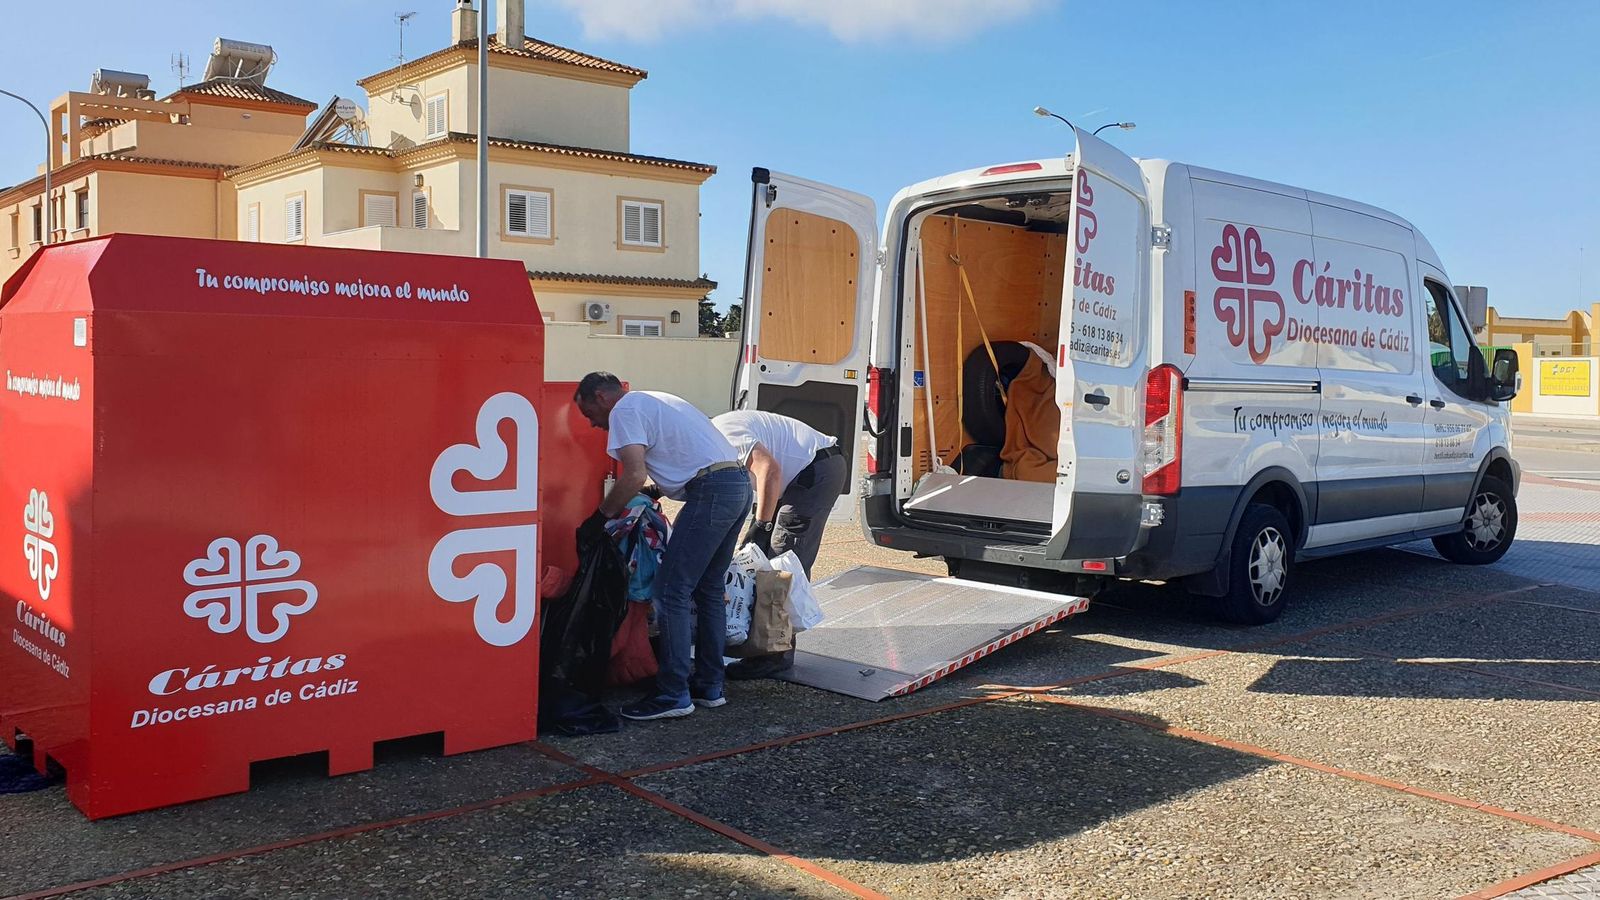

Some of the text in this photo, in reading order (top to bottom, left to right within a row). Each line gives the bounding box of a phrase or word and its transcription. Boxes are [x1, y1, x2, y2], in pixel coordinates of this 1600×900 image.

[195, 268, 470, 302] Tu compromiso mejora el mundo
[1073, 257, 1115, 296] itas
[1292, 259, 1404, 317] Cáritas
[1079, 298, 1090, 313] de
[1093, 301, 1117, 320] Cádiz
[1069, 338, 1121, 360] adiz@caritas.es
[1286, 317, 1409, 352] Diocesana de Cádiz
[1233, 406, 1388, 438] Tu compromiso mejora el mundo
[16, 600, 66, 647] Cáritas
[12, 629, 70, 679] Diocesana de Cádiz
[148, 653, 347, 696] Cáritas
[130, 678, 359, 728] Diocesana de Cádiz
